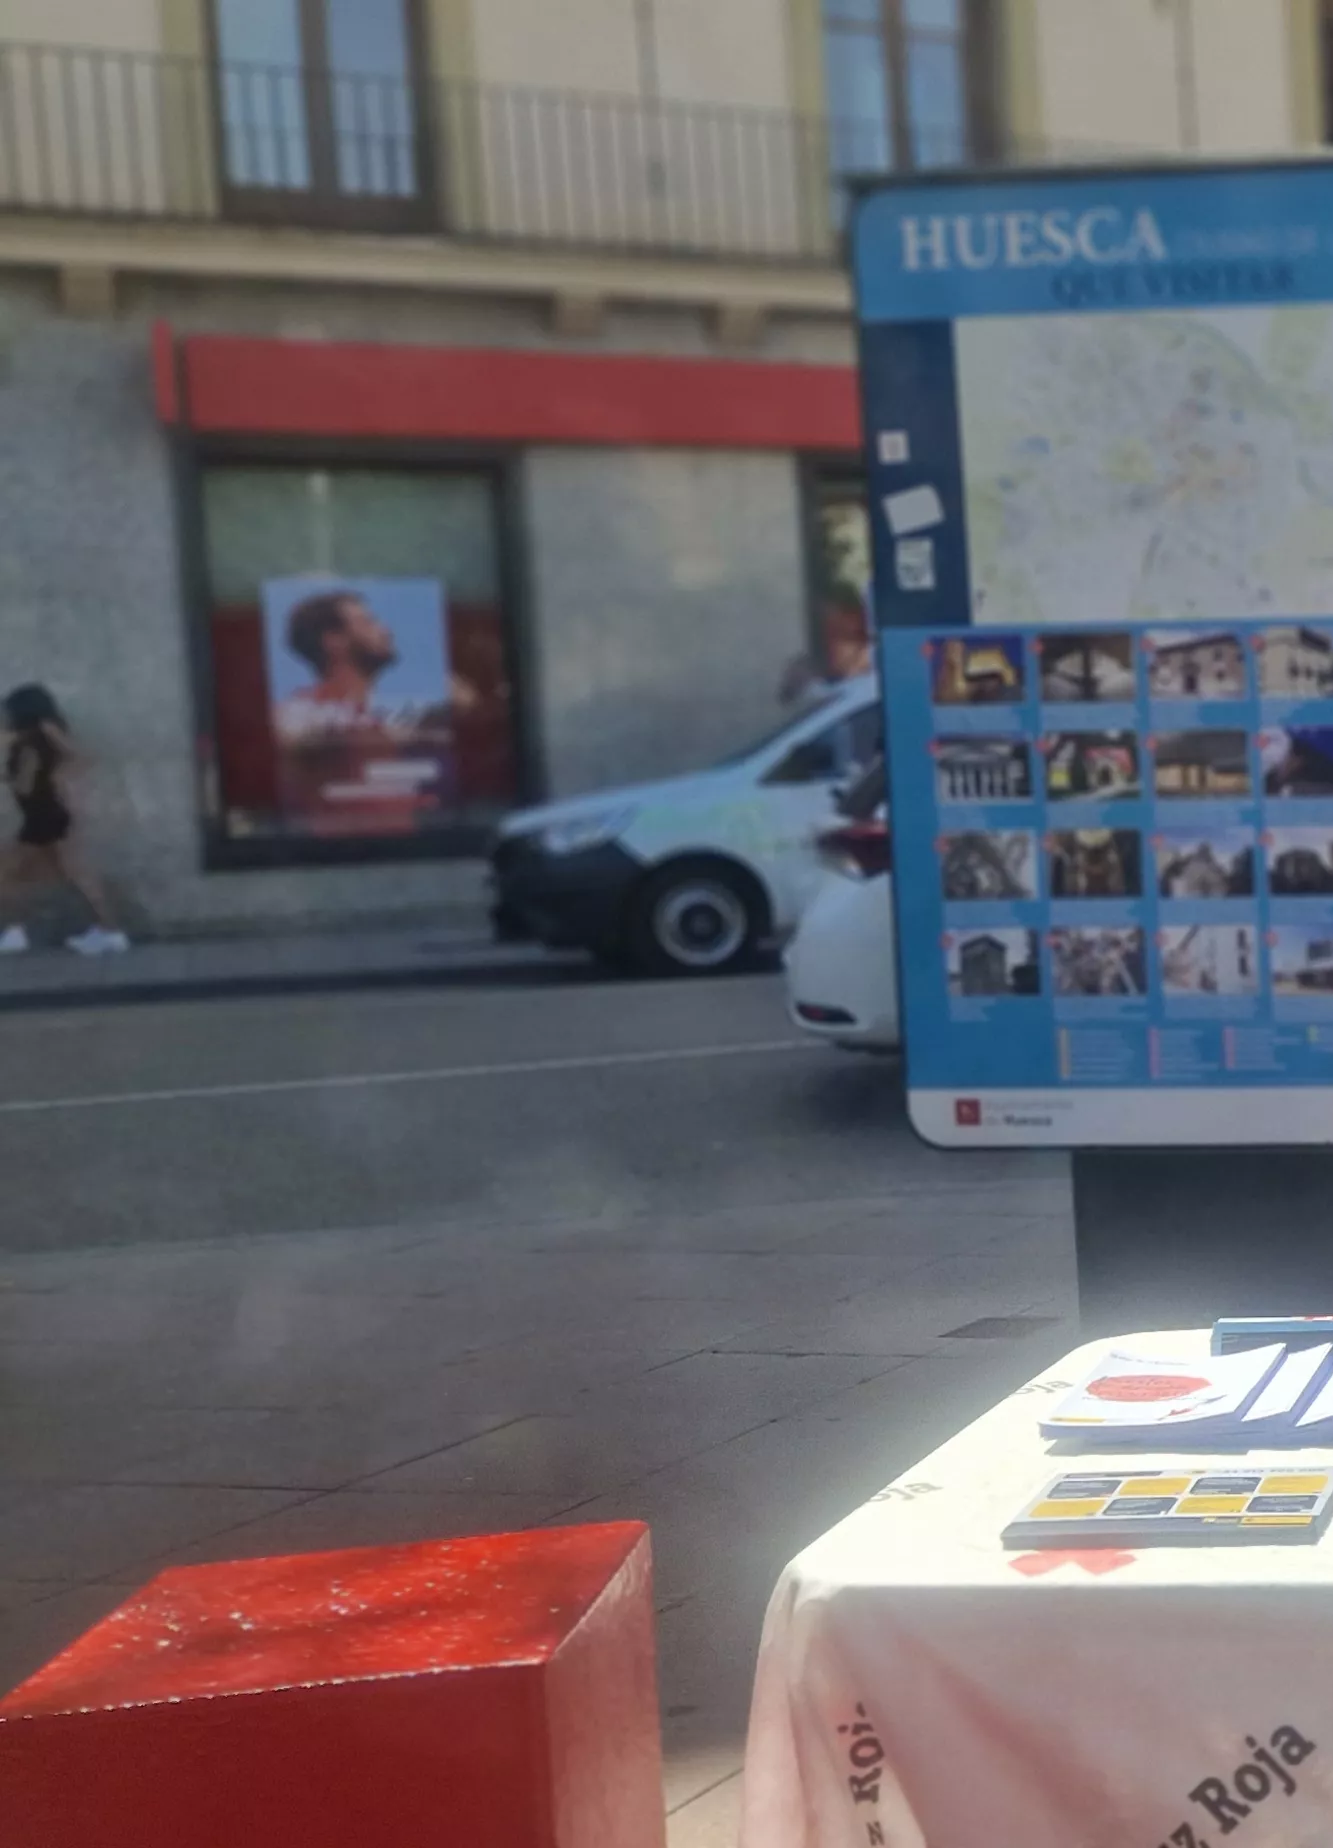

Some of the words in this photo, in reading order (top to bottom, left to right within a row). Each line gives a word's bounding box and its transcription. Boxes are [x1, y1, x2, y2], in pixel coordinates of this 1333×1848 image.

[902, 207, 1167, 271] HUESCA
[1013, 1381, 1075, 1396] oja
[1187, 1723, 1317, 1836] Roja
